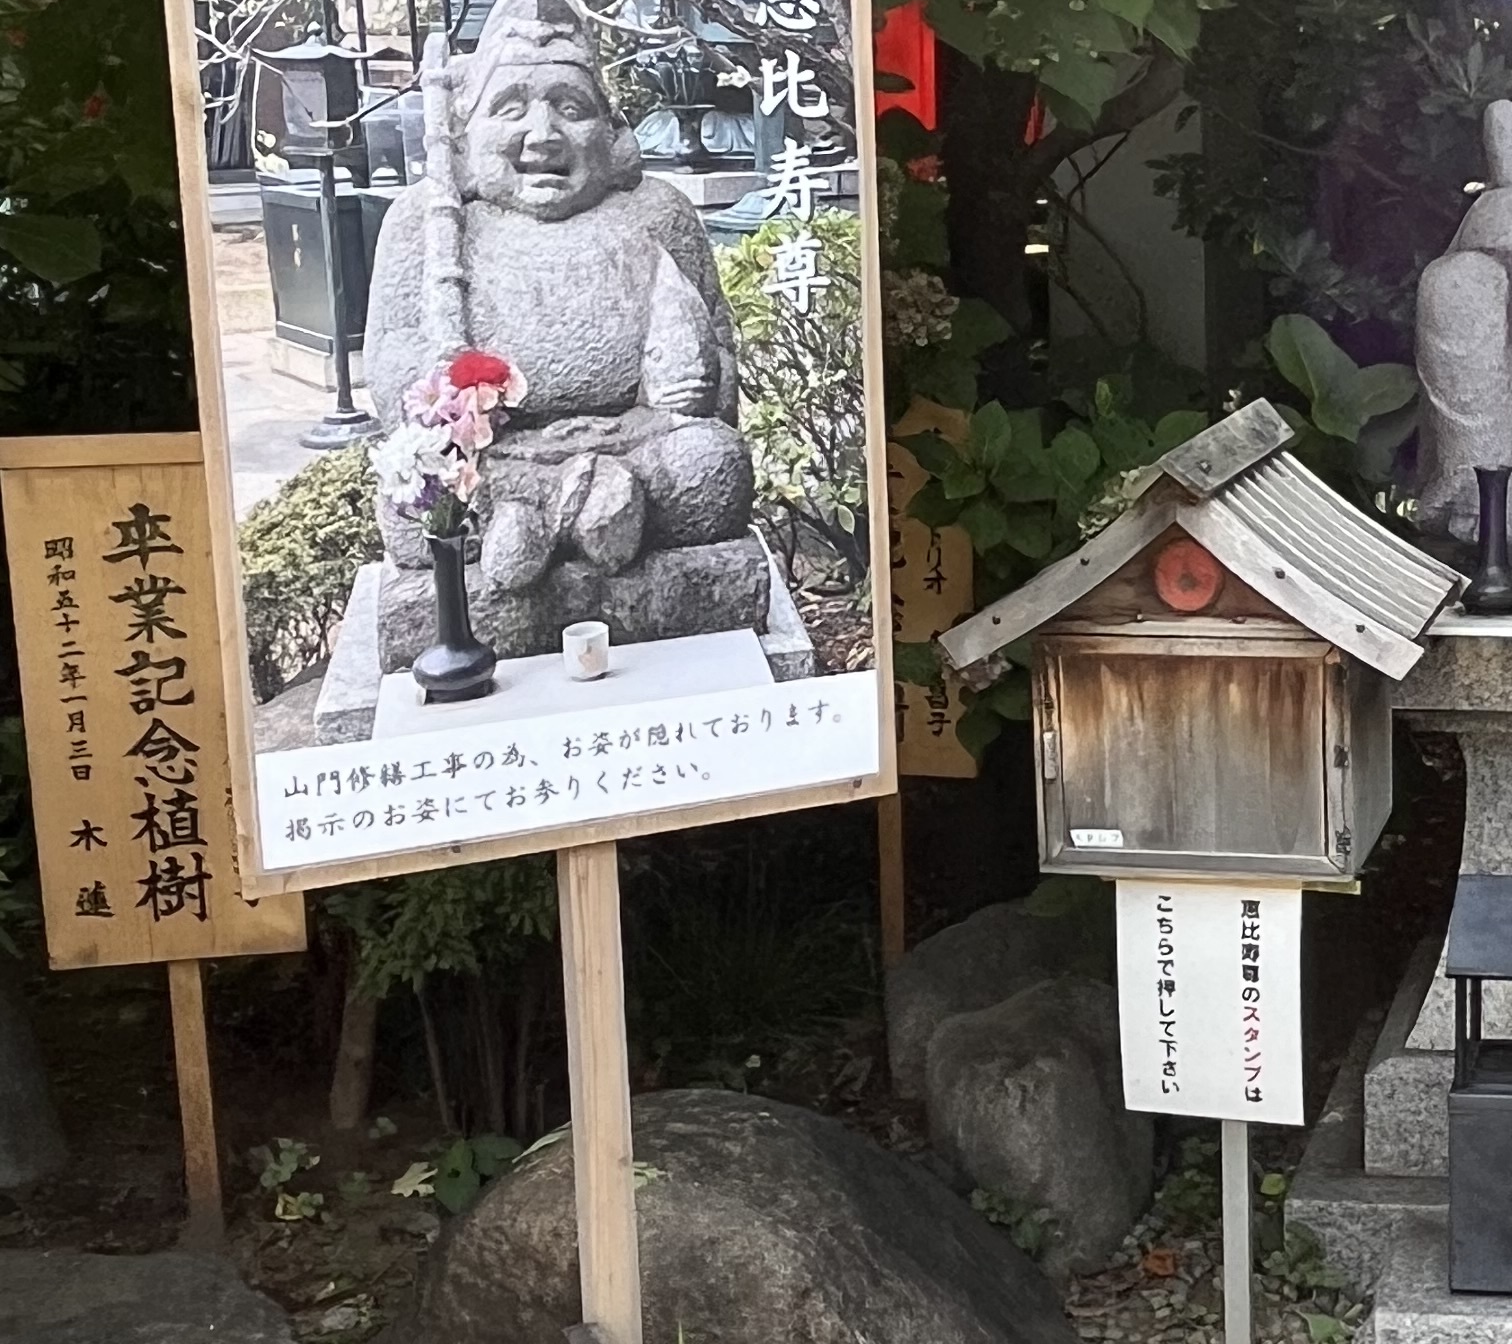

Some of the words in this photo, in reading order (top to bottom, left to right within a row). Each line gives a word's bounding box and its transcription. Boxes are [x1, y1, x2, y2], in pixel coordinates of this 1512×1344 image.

[101, 502, 213, 923] 卒業記念植樹
[284, 762, 711, 842] 掲示のお姿にてお参りください。
[1156, 895, 1180, 1094] こちらで押して下さい
